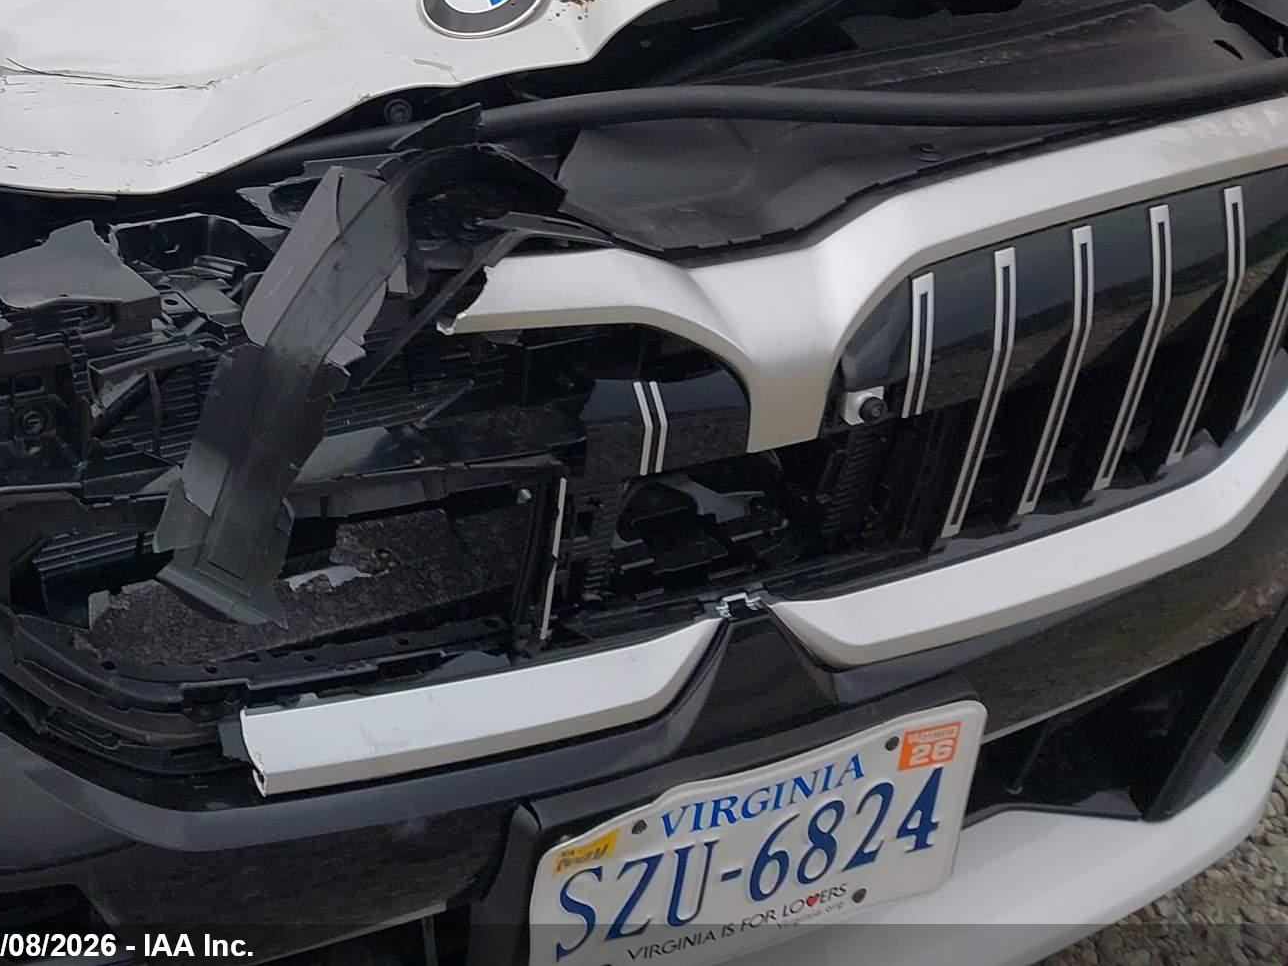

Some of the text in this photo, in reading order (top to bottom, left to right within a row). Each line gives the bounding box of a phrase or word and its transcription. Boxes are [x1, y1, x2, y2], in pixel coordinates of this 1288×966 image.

[908, 739, 954, 767] 26
[660, 752, 866, 839] VIRGINIA
[555, 765, 944, 963] SZU-6824
[626, 930, 716, 961] VIRGINIA
[721, 922, 736, 939] IS
[739, 909, 777, 933] FOR
